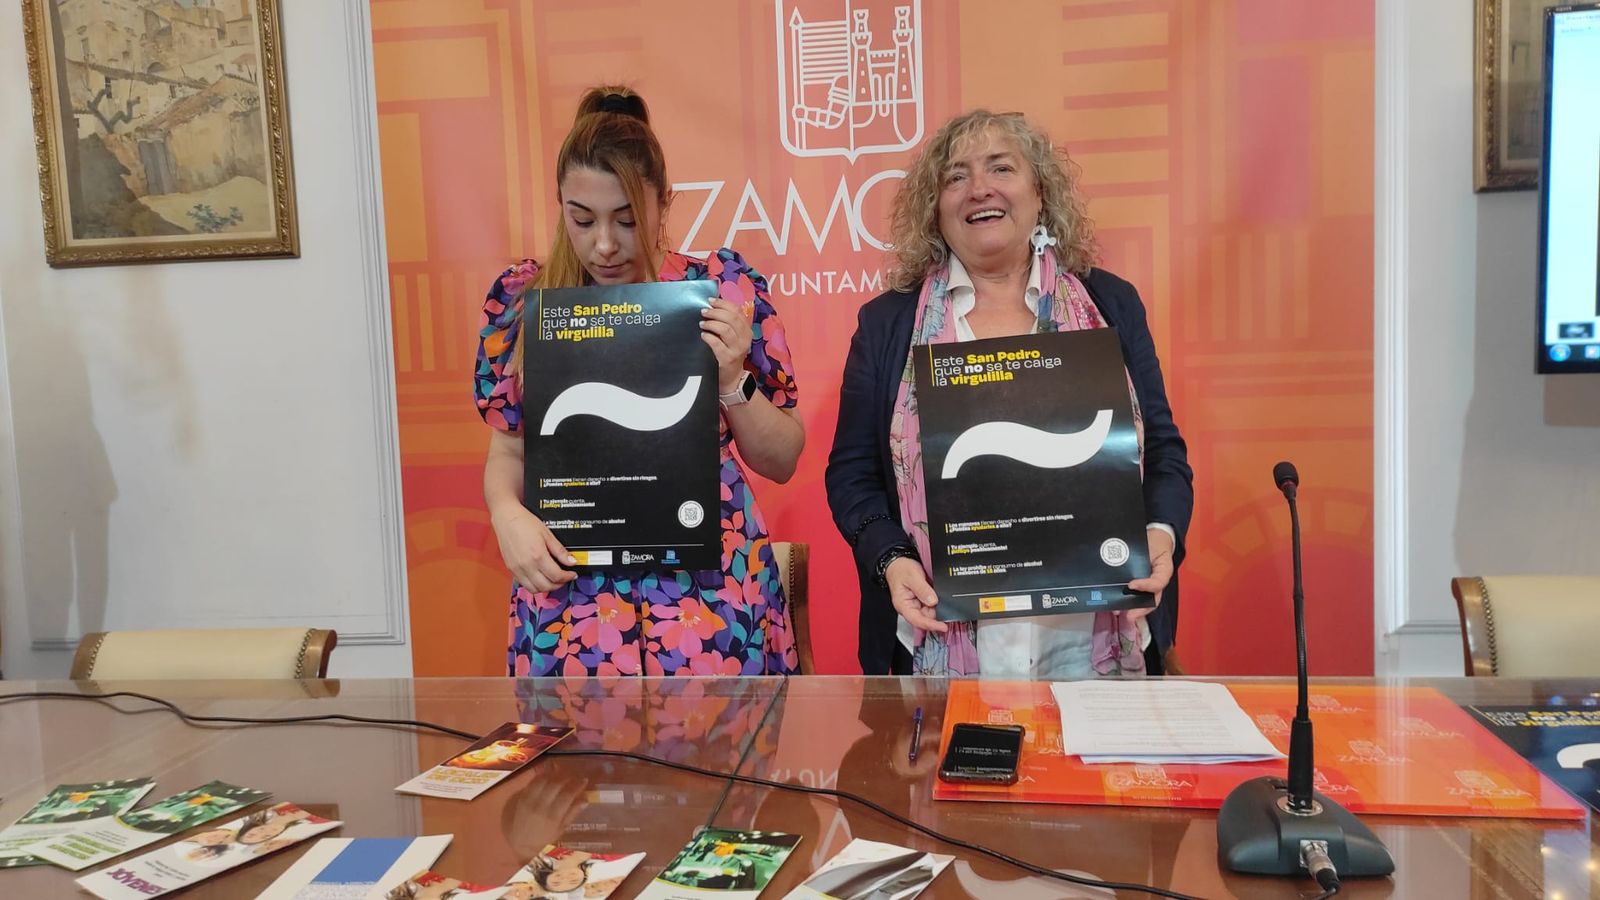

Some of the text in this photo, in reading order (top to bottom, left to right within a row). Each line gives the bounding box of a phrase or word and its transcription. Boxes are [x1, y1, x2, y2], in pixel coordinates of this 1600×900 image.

[672, 170, 907, 258] ZAMO
[762, 269, 884, 296] YUNTAM
[543, 302, 642, 318] Este San Pedro
[543, 312, 661, 330] que no se te caiga
[542, 326, 615, 342] la virgulilla
[933, 349, 1041, 368] Este San Pedro
[935, 356, 1062, 378] que no se te caiga
[936, 370, 1014, 387] la virgulilla
[1051, 596, 1078, 604] ZAMORA
